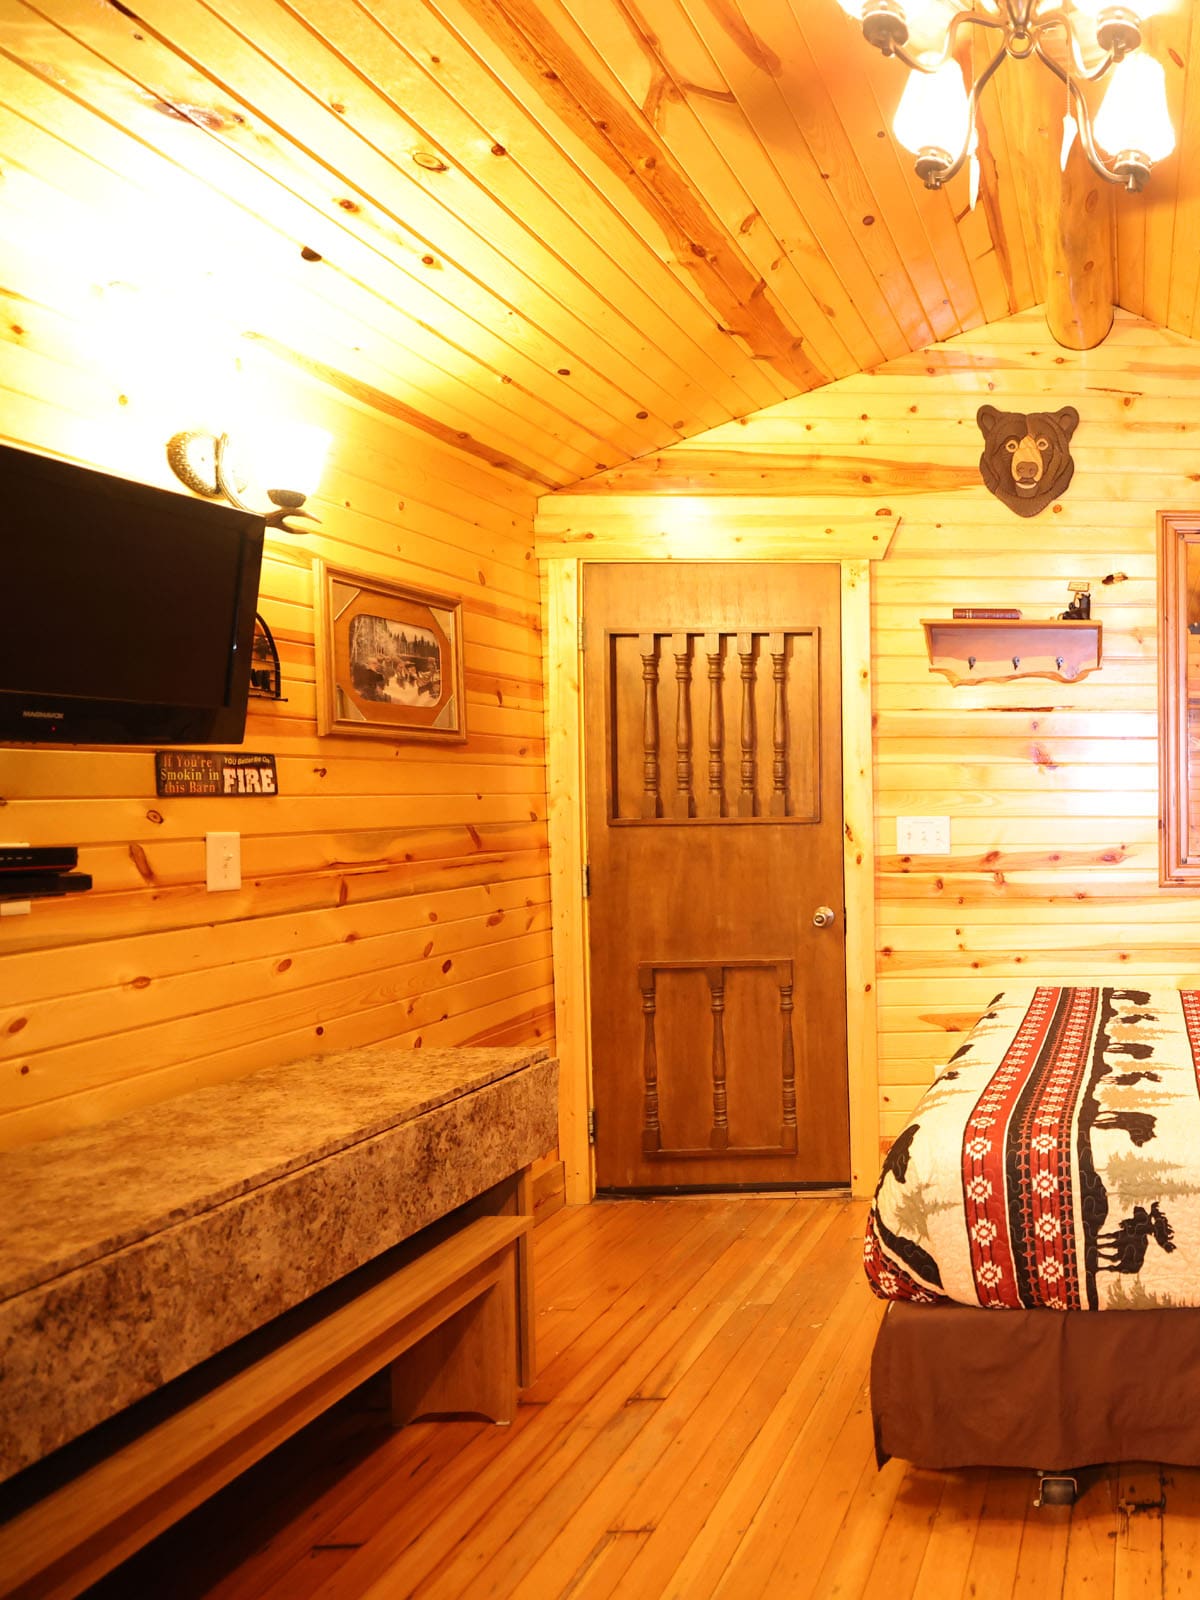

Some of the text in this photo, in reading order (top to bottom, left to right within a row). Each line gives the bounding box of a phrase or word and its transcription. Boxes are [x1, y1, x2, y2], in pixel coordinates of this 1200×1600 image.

[163, 755, 212, 768] If You're
[161, 768, 219, 781] Smokin' in
[223, 768, 275, 793] FIRE
[164, 781, 216, 793] this Barn
